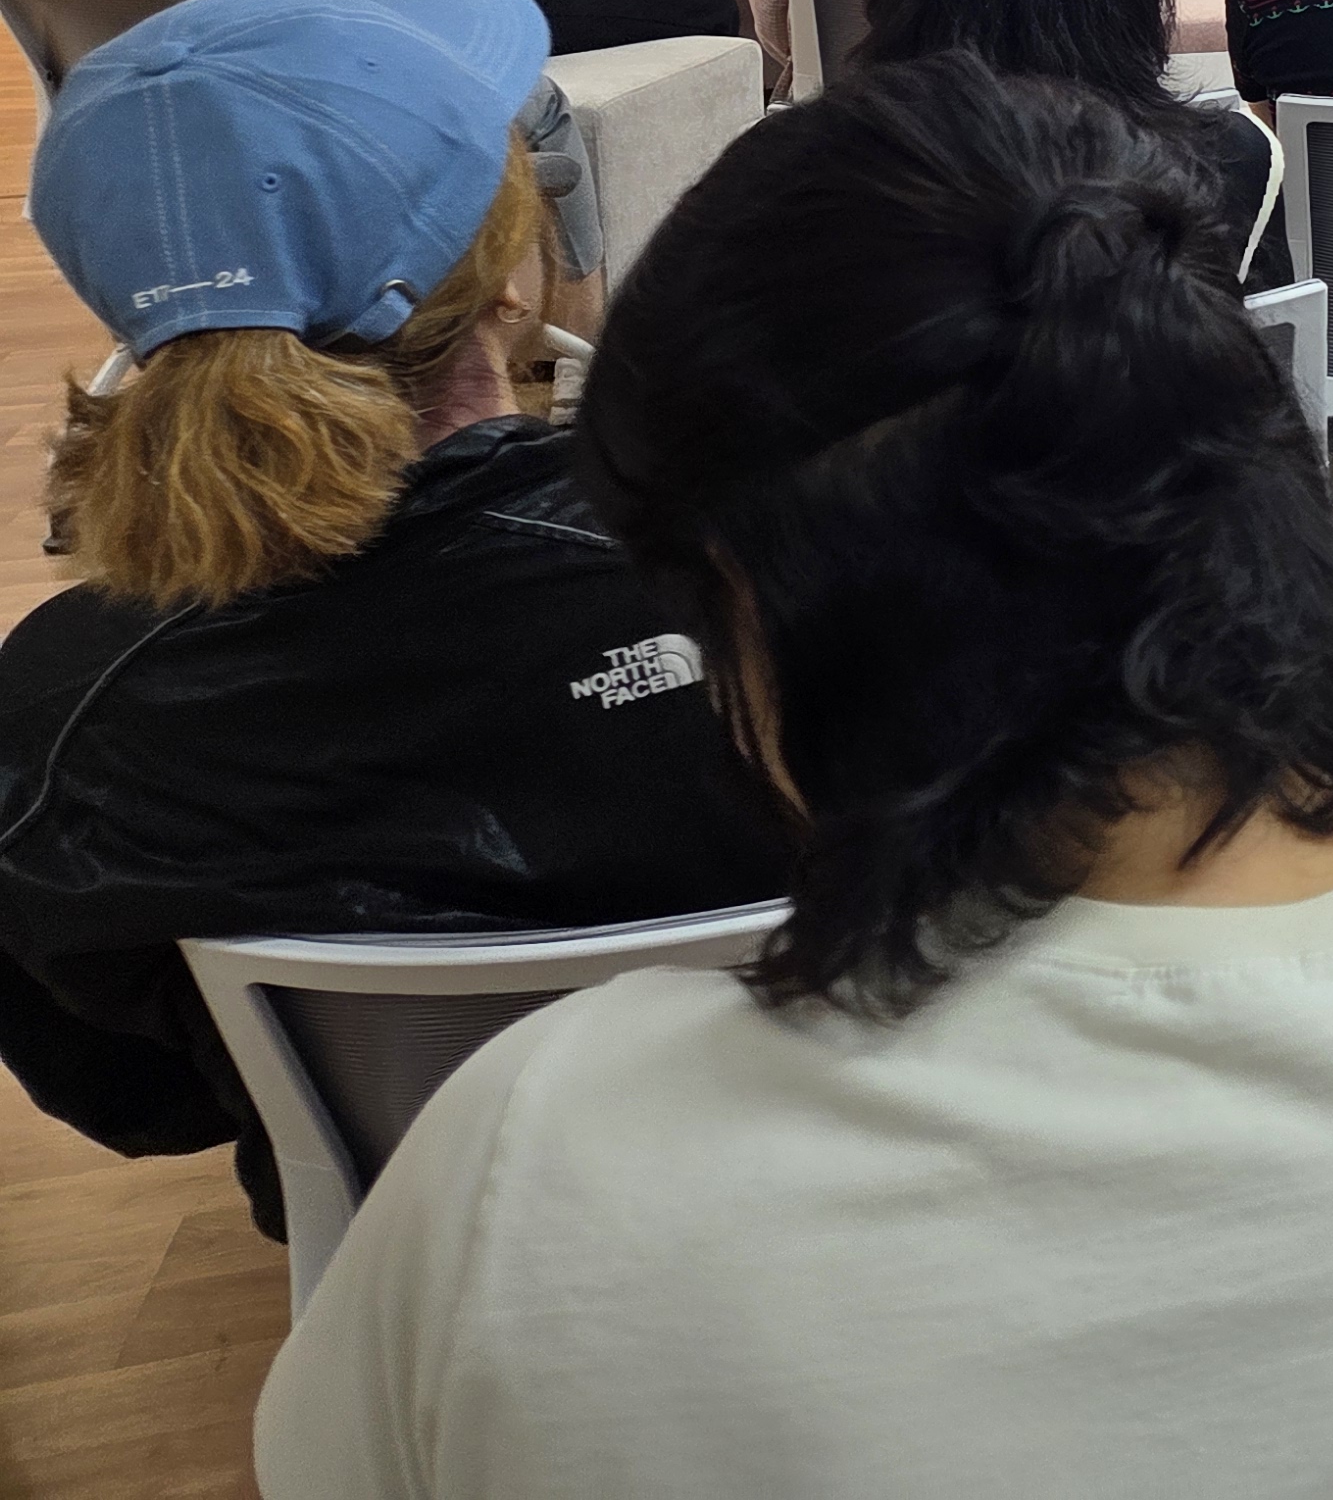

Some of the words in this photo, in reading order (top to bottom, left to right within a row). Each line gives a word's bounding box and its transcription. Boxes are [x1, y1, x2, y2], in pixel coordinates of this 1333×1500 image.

[602, 638, 658, 667] THE
[570, 657, 662, 699] NORTH
[601, 674, 668, 709] FACE
